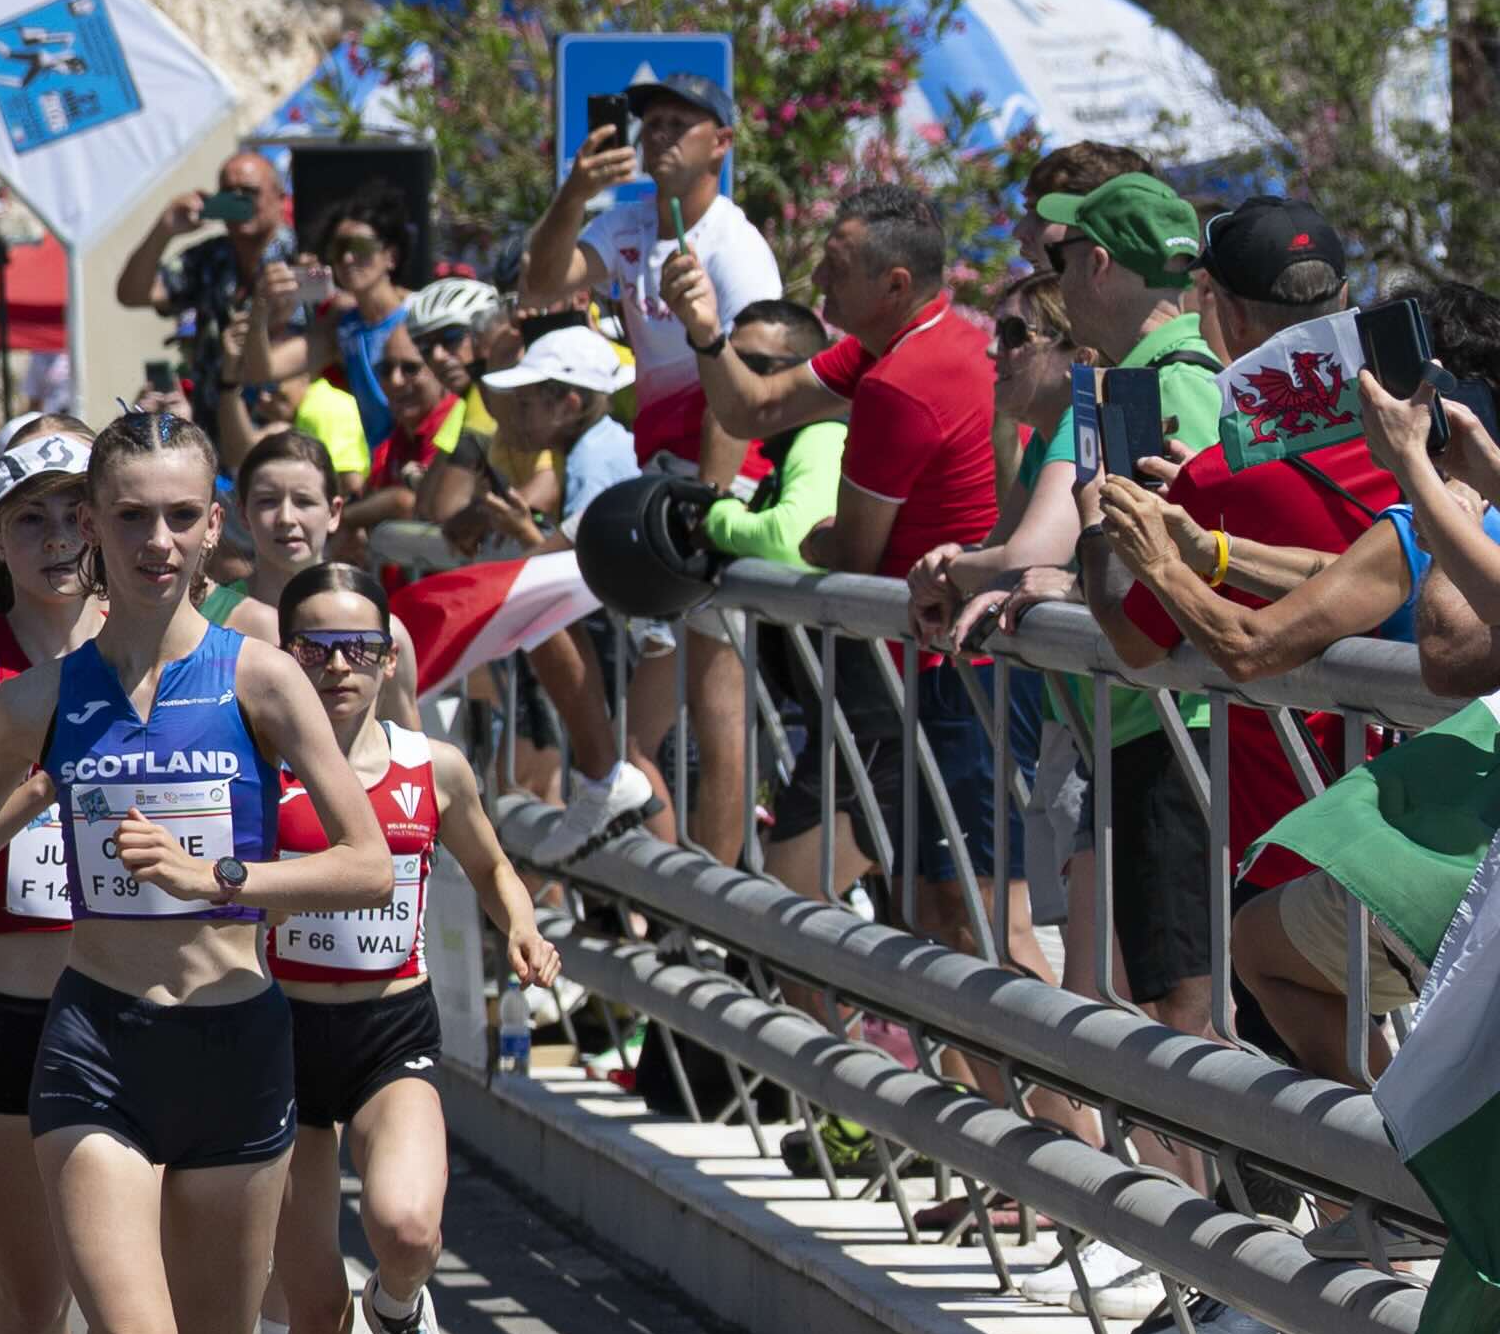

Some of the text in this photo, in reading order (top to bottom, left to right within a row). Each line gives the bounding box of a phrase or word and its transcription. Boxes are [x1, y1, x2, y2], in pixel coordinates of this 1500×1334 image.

[60, 751, 239, 785] SCOTLAND
[21, 880, 36, 898] F
[93, 876, 140, 896] F 39
[289, 930, 405, 953] F 66 WAL
